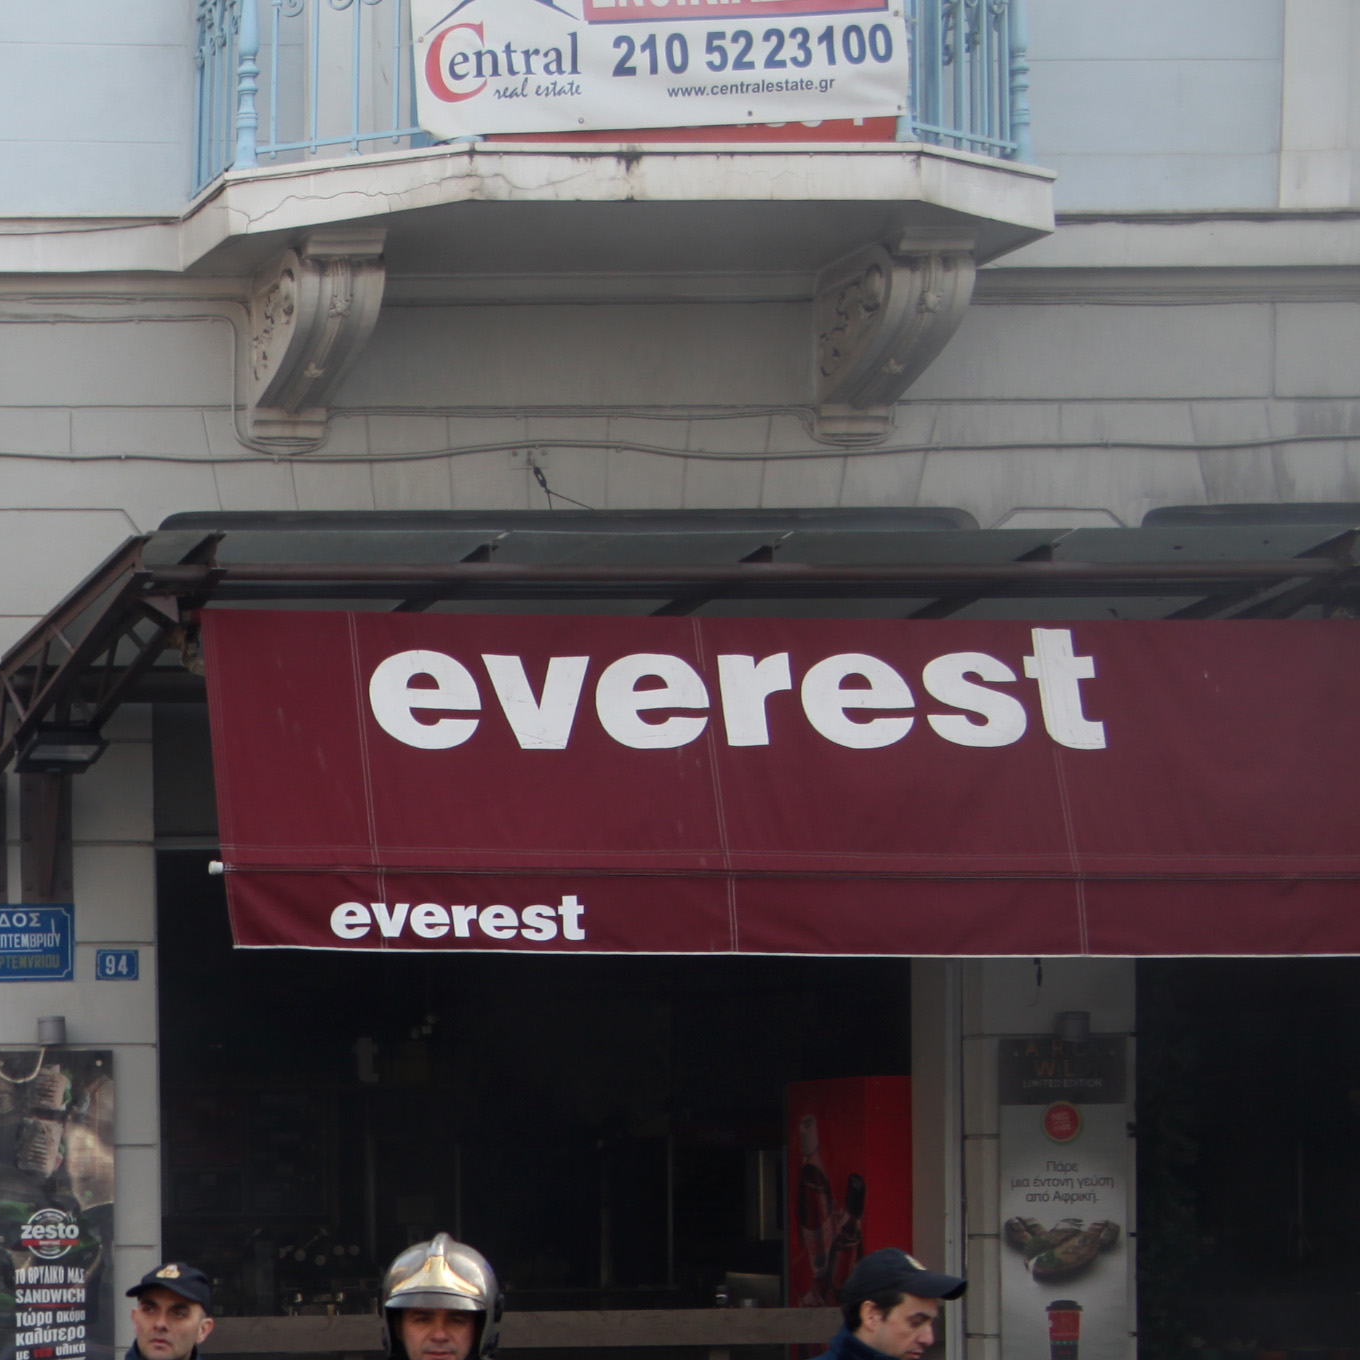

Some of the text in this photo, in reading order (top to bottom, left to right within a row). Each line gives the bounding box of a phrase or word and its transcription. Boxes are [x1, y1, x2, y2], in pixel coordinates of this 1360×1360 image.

[612, 23, 893, 77] 210 5223100
[424, 20, 581, 103] Central
[493, 77, 582, 99] real estate
[666, 77, 835, 98] www.centralestate.gr
[368, 627, 1106, 750] everest
[330, 894, 585, 941] everest
[105, 955, 128, 976] 94
[1046, 1160, 1079, 1173] Πάρε
[1011, 1175, 1114, 1190] μια έντονη γεύση
[1026, 1190, 1050, 1203] από
[20, 1222, 80, 1240] zesto
[15, 1266, 85, 1284] ΤΟ ΘΡΥΛΙΚΟ ΜΑΣ
[15, 1288, 86, 1304] SANDWICH
[15, 1308, 86, 1327] τώρα ακόμα
[15, 1325, 86, 1346] καλύτερο
[55, 1341, 86, 1356] υλικά
